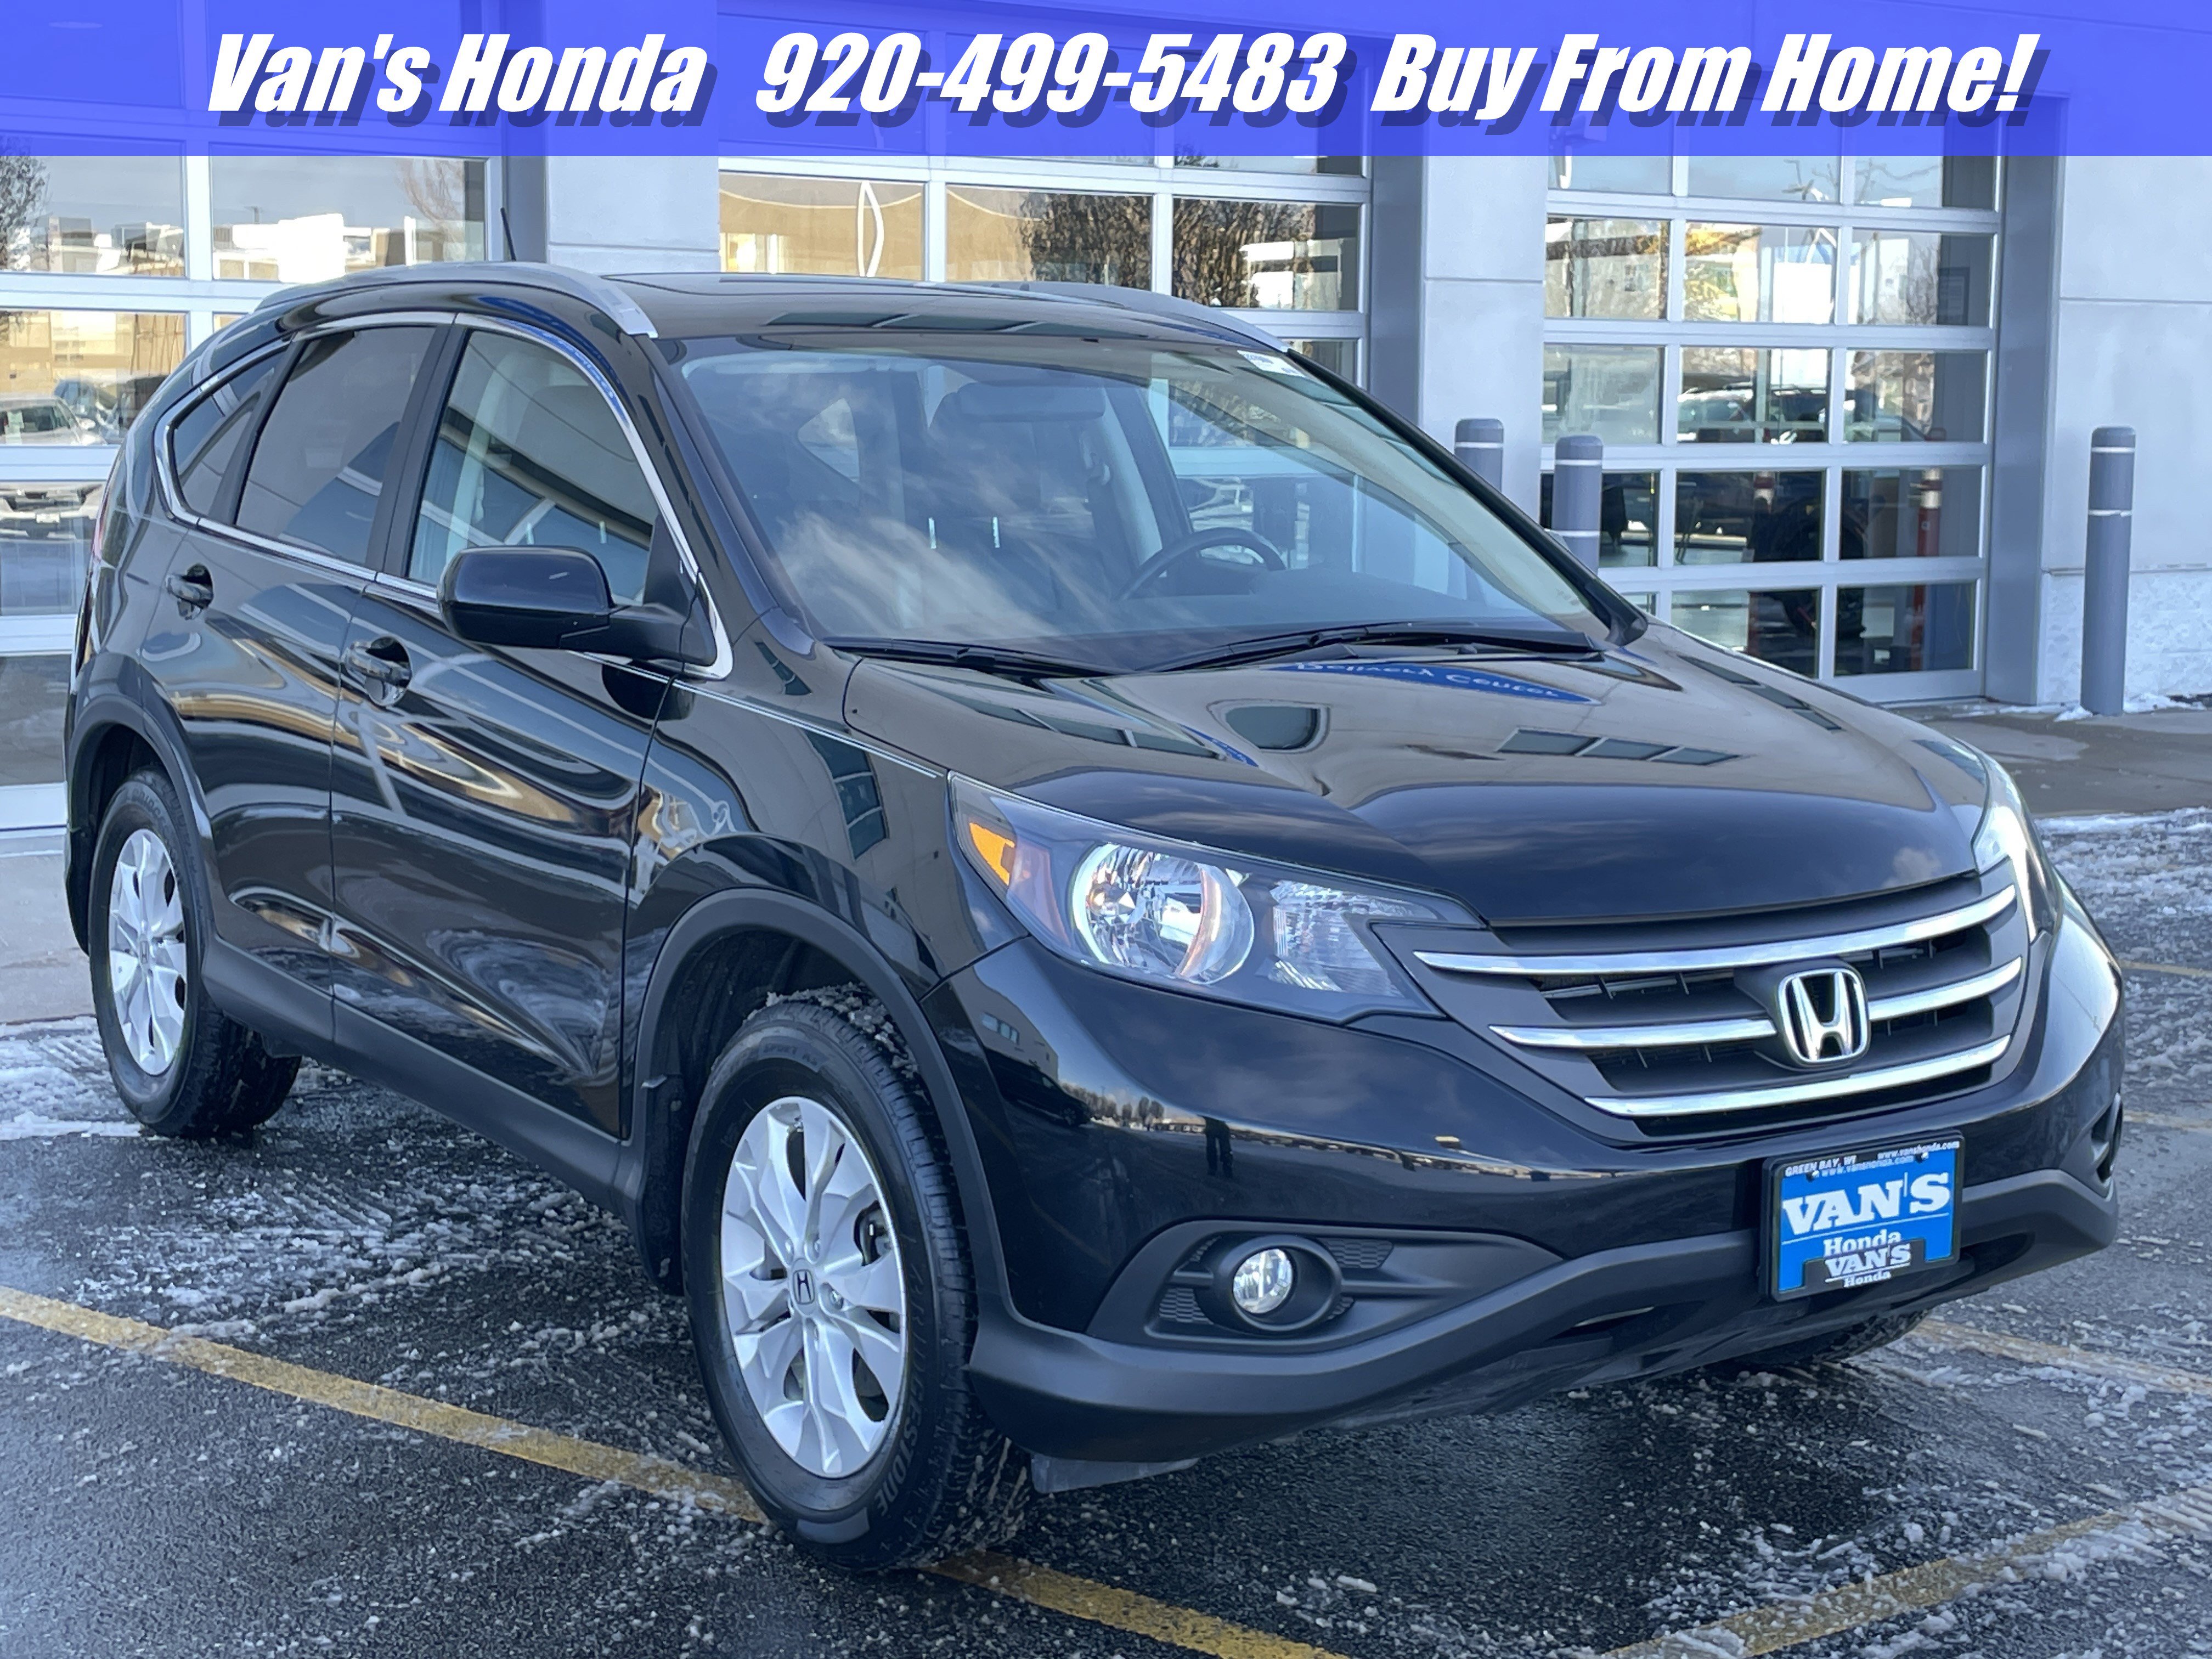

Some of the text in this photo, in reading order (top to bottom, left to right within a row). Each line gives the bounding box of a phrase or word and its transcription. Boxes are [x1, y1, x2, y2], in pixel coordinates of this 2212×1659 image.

[1785, 1161, 1818, 1177] GREEN
[1782, 1172, 1951, 1235] VAN'S
[1824, 1229, 1901, 1257] Honda
[1825, 1244, 1911, 1277] VAN'S
[1843, 1271, 1891, 1288] Honda
